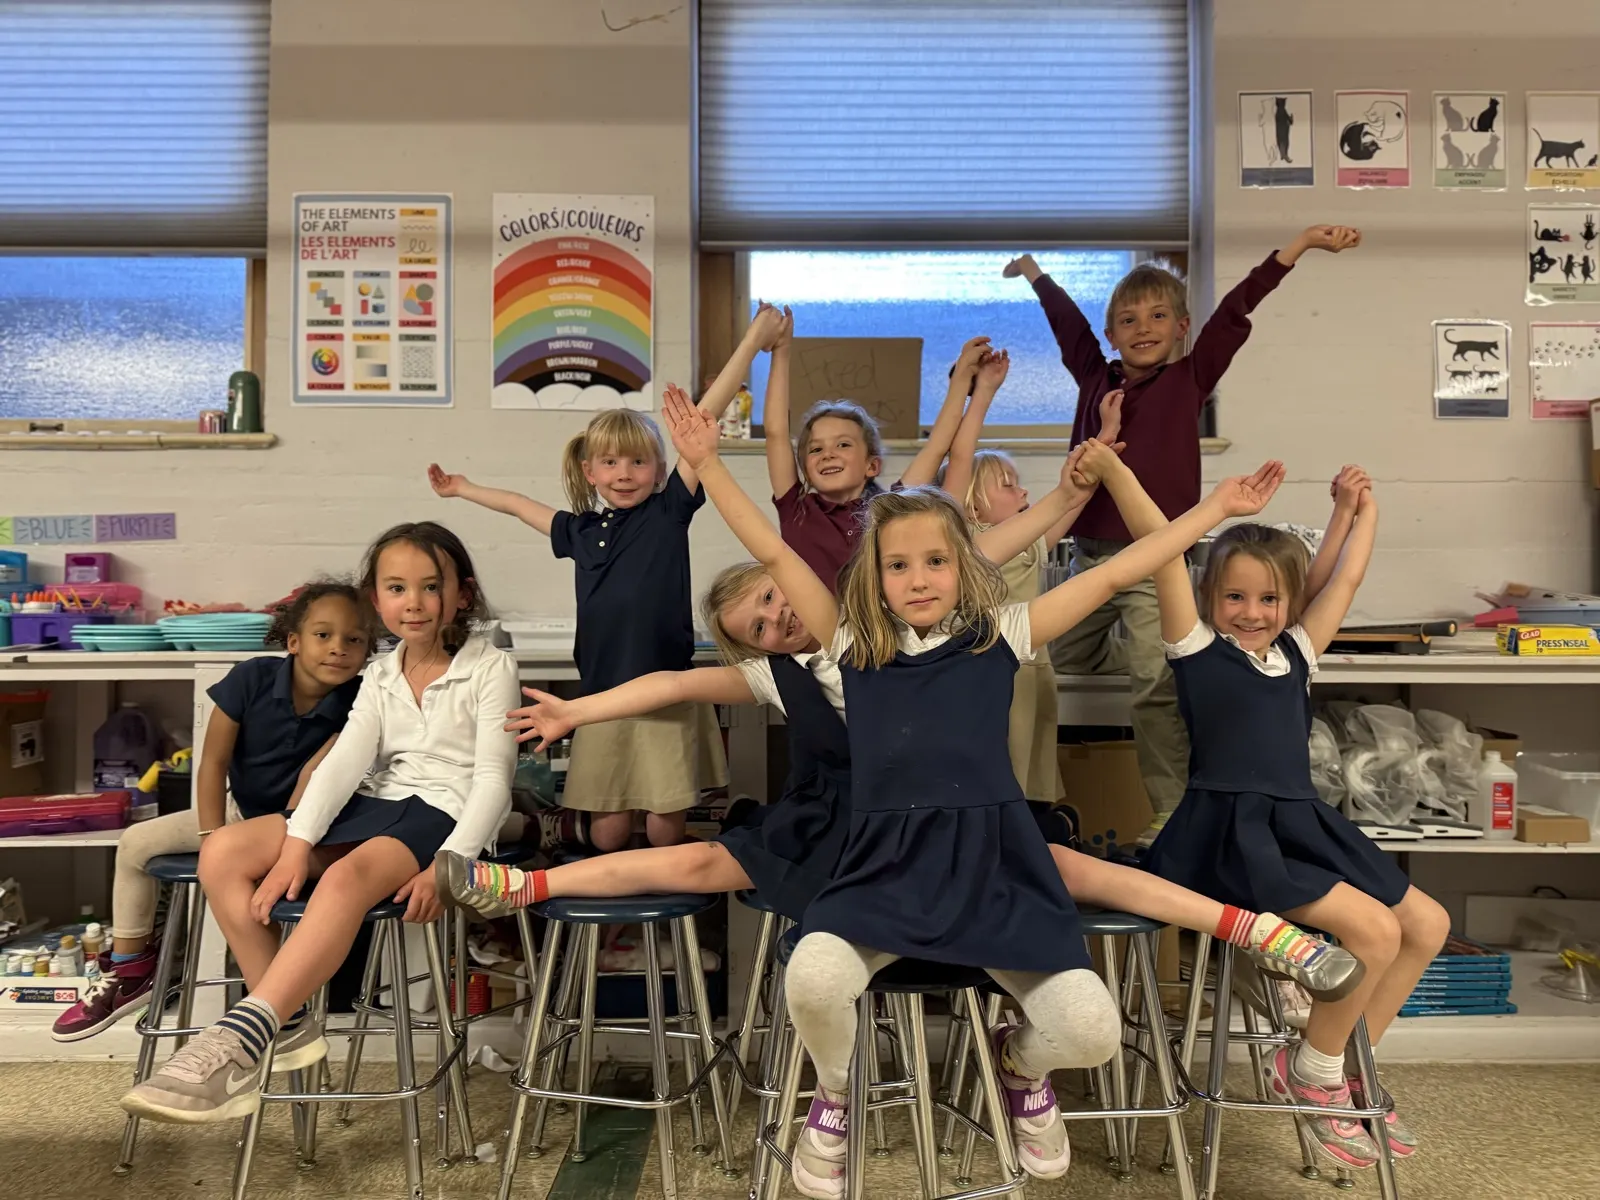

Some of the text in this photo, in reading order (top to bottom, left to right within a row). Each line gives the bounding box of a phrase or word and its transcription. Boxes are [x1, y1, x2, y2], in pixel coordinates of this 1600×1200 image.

[302, 208, 396, 220] THE ELEMENTS
[301, 221, 349, 232] OF ART
[301, 236, 396, 248] LES ELEMENTS
[301, 249, 359, 260] DE L'ART
[29, 517, 79, 541] BLUE
[110, 515, 162, 538] PURPLE
[1520, 630, 1539, 640] GLAD
[1023, 1087, 1049, 1111] NIKE
